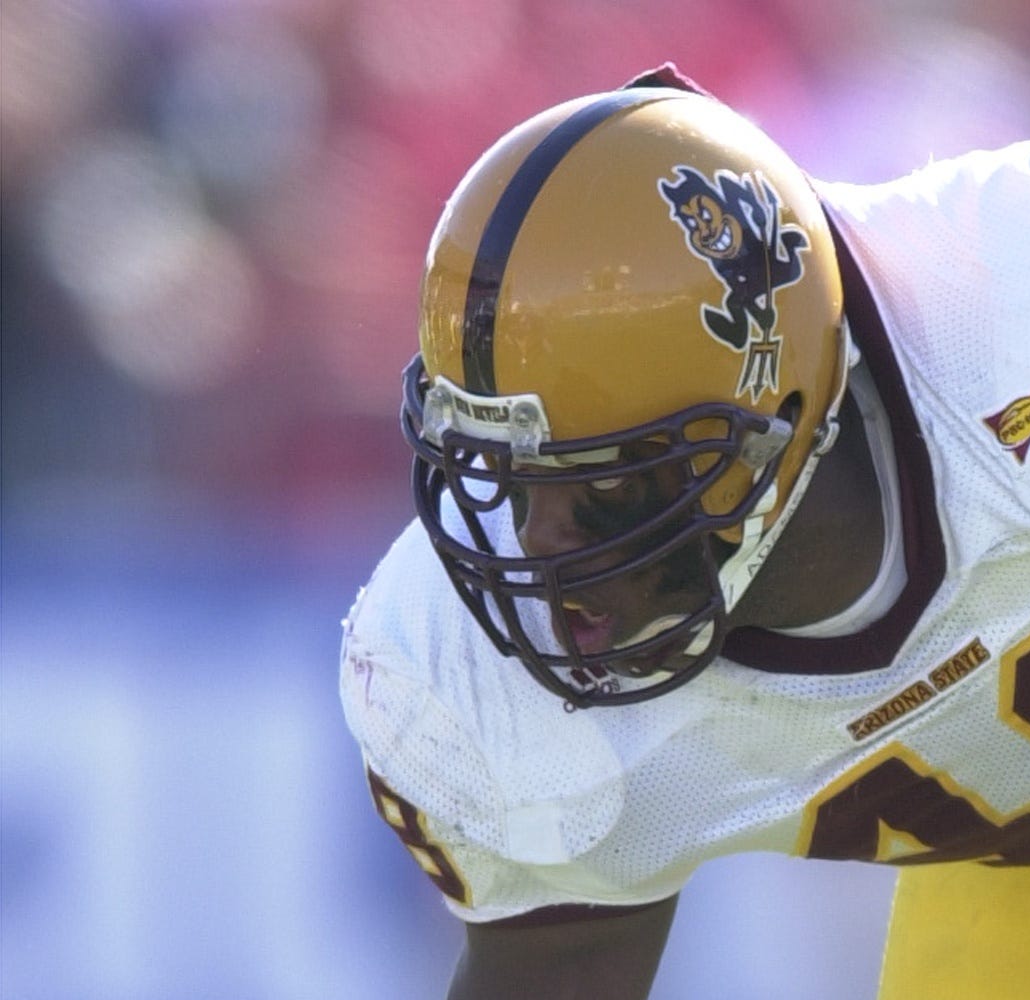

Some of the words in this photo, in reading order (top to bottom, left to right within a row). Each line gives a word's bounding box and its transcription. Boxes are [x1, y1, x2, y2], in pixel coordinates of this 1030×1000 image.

[848, 680, 936, 741] ARIZONA
[929, 638, 990, 691] STATE
[366, 762, 474, 909] 8
